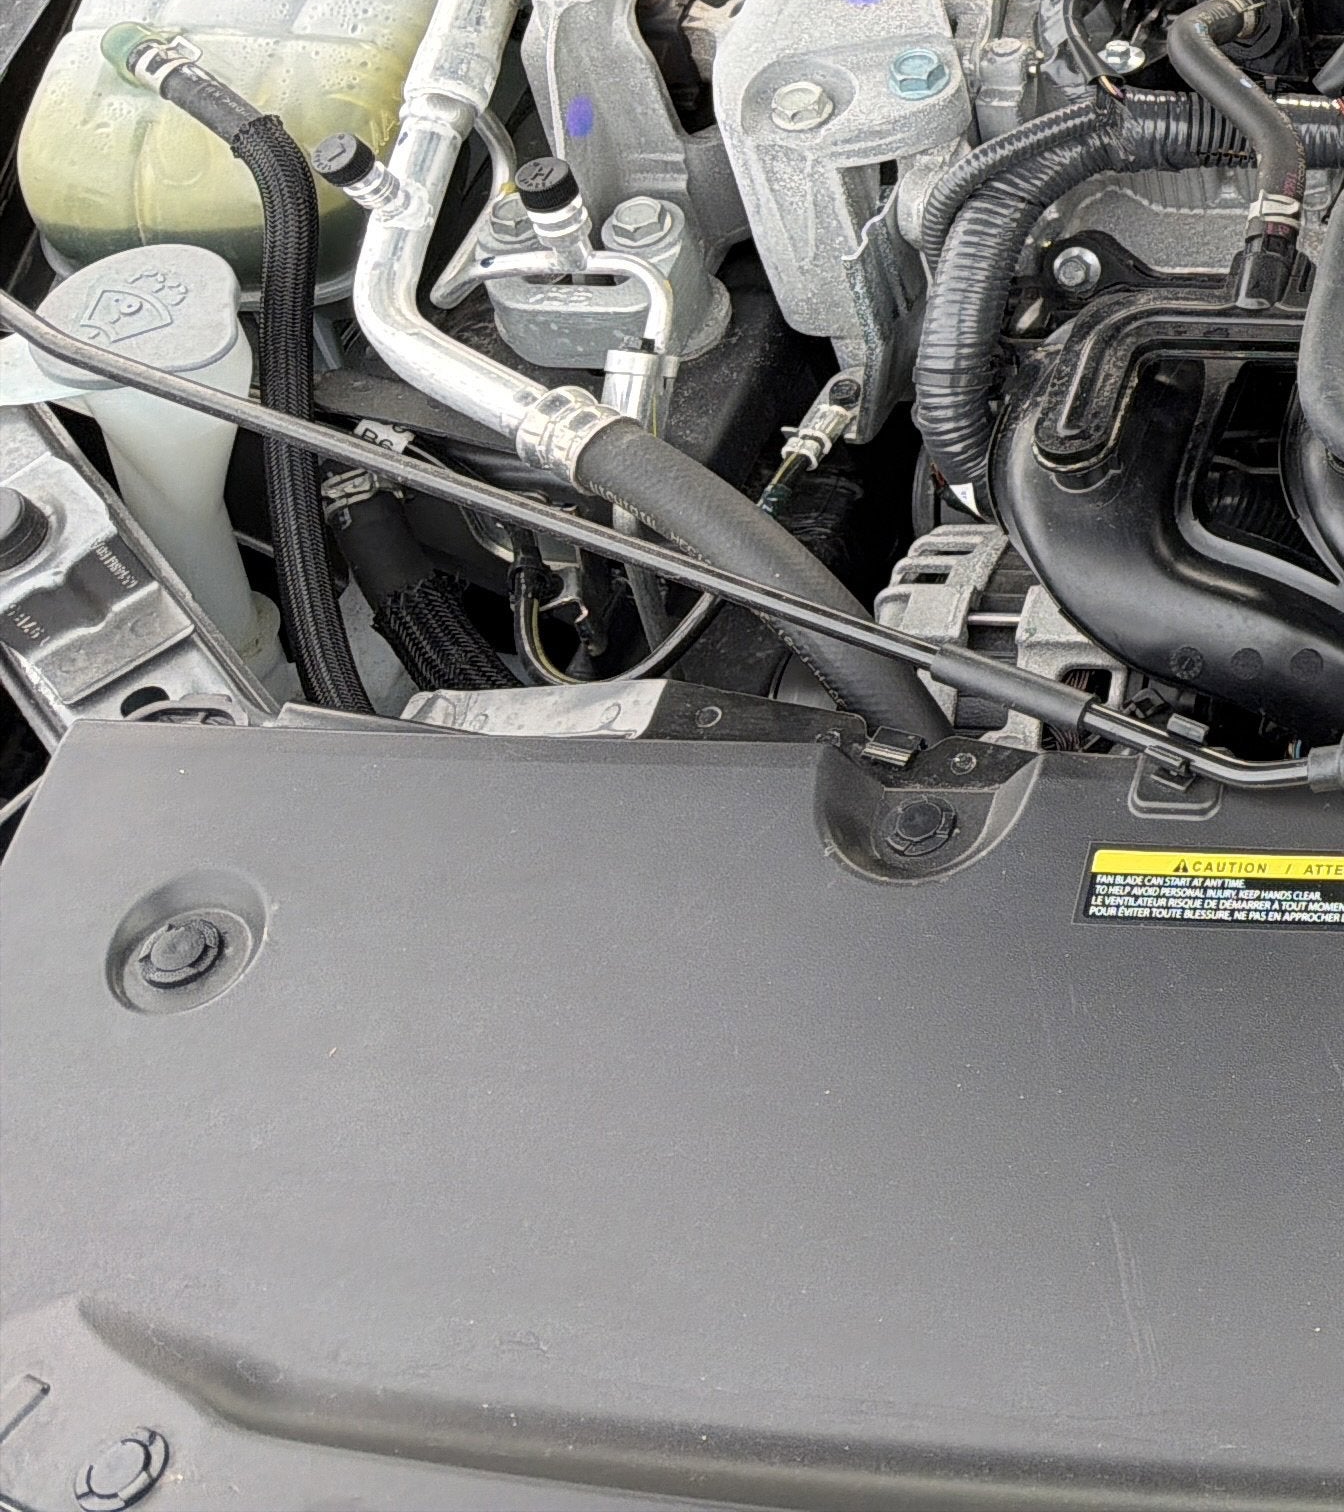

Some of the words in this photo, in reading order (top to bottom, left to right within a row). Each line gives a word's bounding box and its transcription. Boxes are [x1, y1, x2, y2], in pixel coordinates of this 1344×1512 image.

[1192, 861, 1268, 874] CAUTION
[1096, 875, 1114, 884] FAN
[1115, 875, 1143, 885] BLADE
[1144, 876, 1164, 885] CAN
[1165, 877, 1190, 886] START
[1192, 877, 1203, 887] AT
[1204, 878, 1222, 888] ANY
[1224, 878, 1246, 888] TIME.
[1095, 885, 1107, 894] TO
[1108, 886, 1130, 895] HELP
[1131, 886, 1160, 896] AVOID
[1161, 887, 1204, 898] PERSONAL
[1239, 890, 1260, 899] KEEP
[1261, 890, 1292, 900] HANDS
[1091, 895, 1103, 905] LE
[1104, 896, 1167, 907] VENTILATEUR
[1168, 898, 1203, 909] RISQUE
[1204, 899, 1217, 908] DE
[1219, 898, 1271, 910] DÉMARRER
[1281, 901, 1307, 911] TOUT
[1089, 906, 1117, 916] POUR
[1118, 905, 1151, 917] ÉVITER
[1152, 908, 1182, 918] TOUTE
[1234, 911, 1248, 920] NE
[1249, 912, 1266, 921] PAS
[1268, 912, 1282, 921] EN
[1282, 912, 1340, 923] APPROCHER
